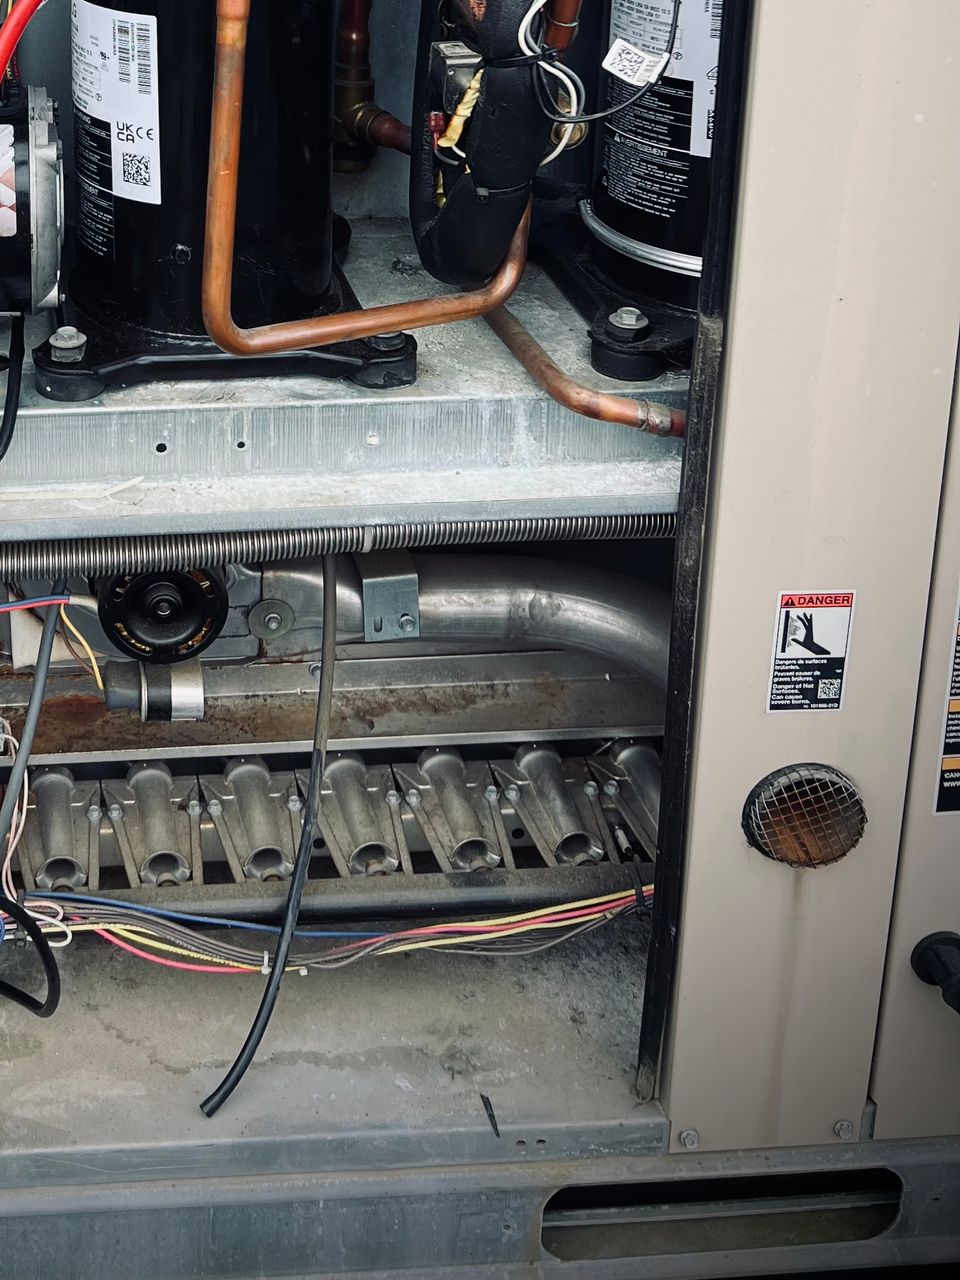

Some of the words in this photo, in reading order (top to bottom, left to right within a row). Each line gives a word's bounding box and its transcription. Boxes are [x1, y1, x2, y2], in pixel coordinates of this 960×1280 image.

[116, 121, 134, 133] UK
[620, 136, 668, 157] AVERTISSEMENT
[797, 596, 850, 605] DANGER
